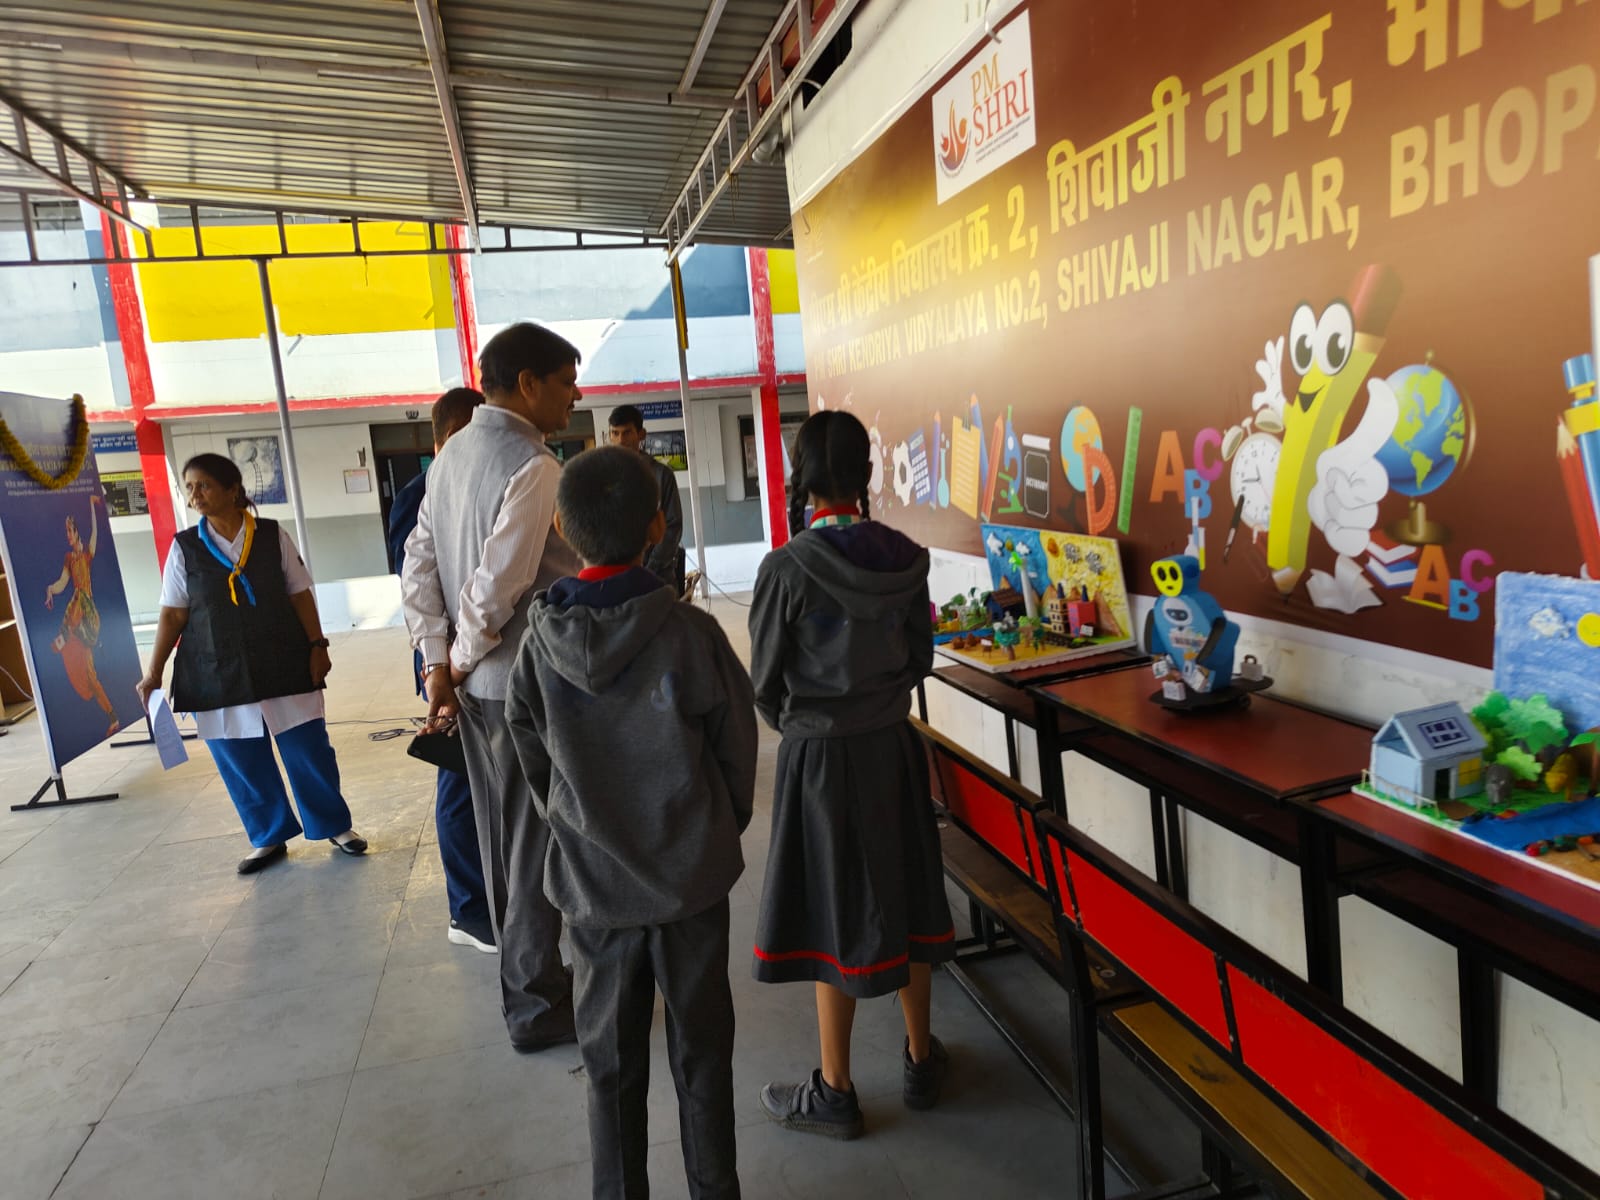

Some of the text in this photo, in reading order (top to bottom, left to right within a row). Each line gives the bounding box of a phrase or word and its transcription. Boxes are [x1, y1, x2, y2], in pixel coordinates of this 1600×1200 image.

[892, 219, 963, 303] विद्यालय
[1007, 184, 1039, 258] 2,
[1046, 75, 1191, 235] शिवाजी
[1202, 12, 1354, 158] नगर,
[971, 52, 1001, 107] PM
[973, 67, 1030, 147] SHRI
[848, 323, 901, 374] KENDRIYA
[904, 289, 988, 357] VIDYALAYA
[995, 270, 1048, 329] NO.2,
[1057, 221, 1169, 313] SHIVAJI
[1187, 156, 1360, 275] NAGAR,
[1390, 63, 1600, 218] BHOP
